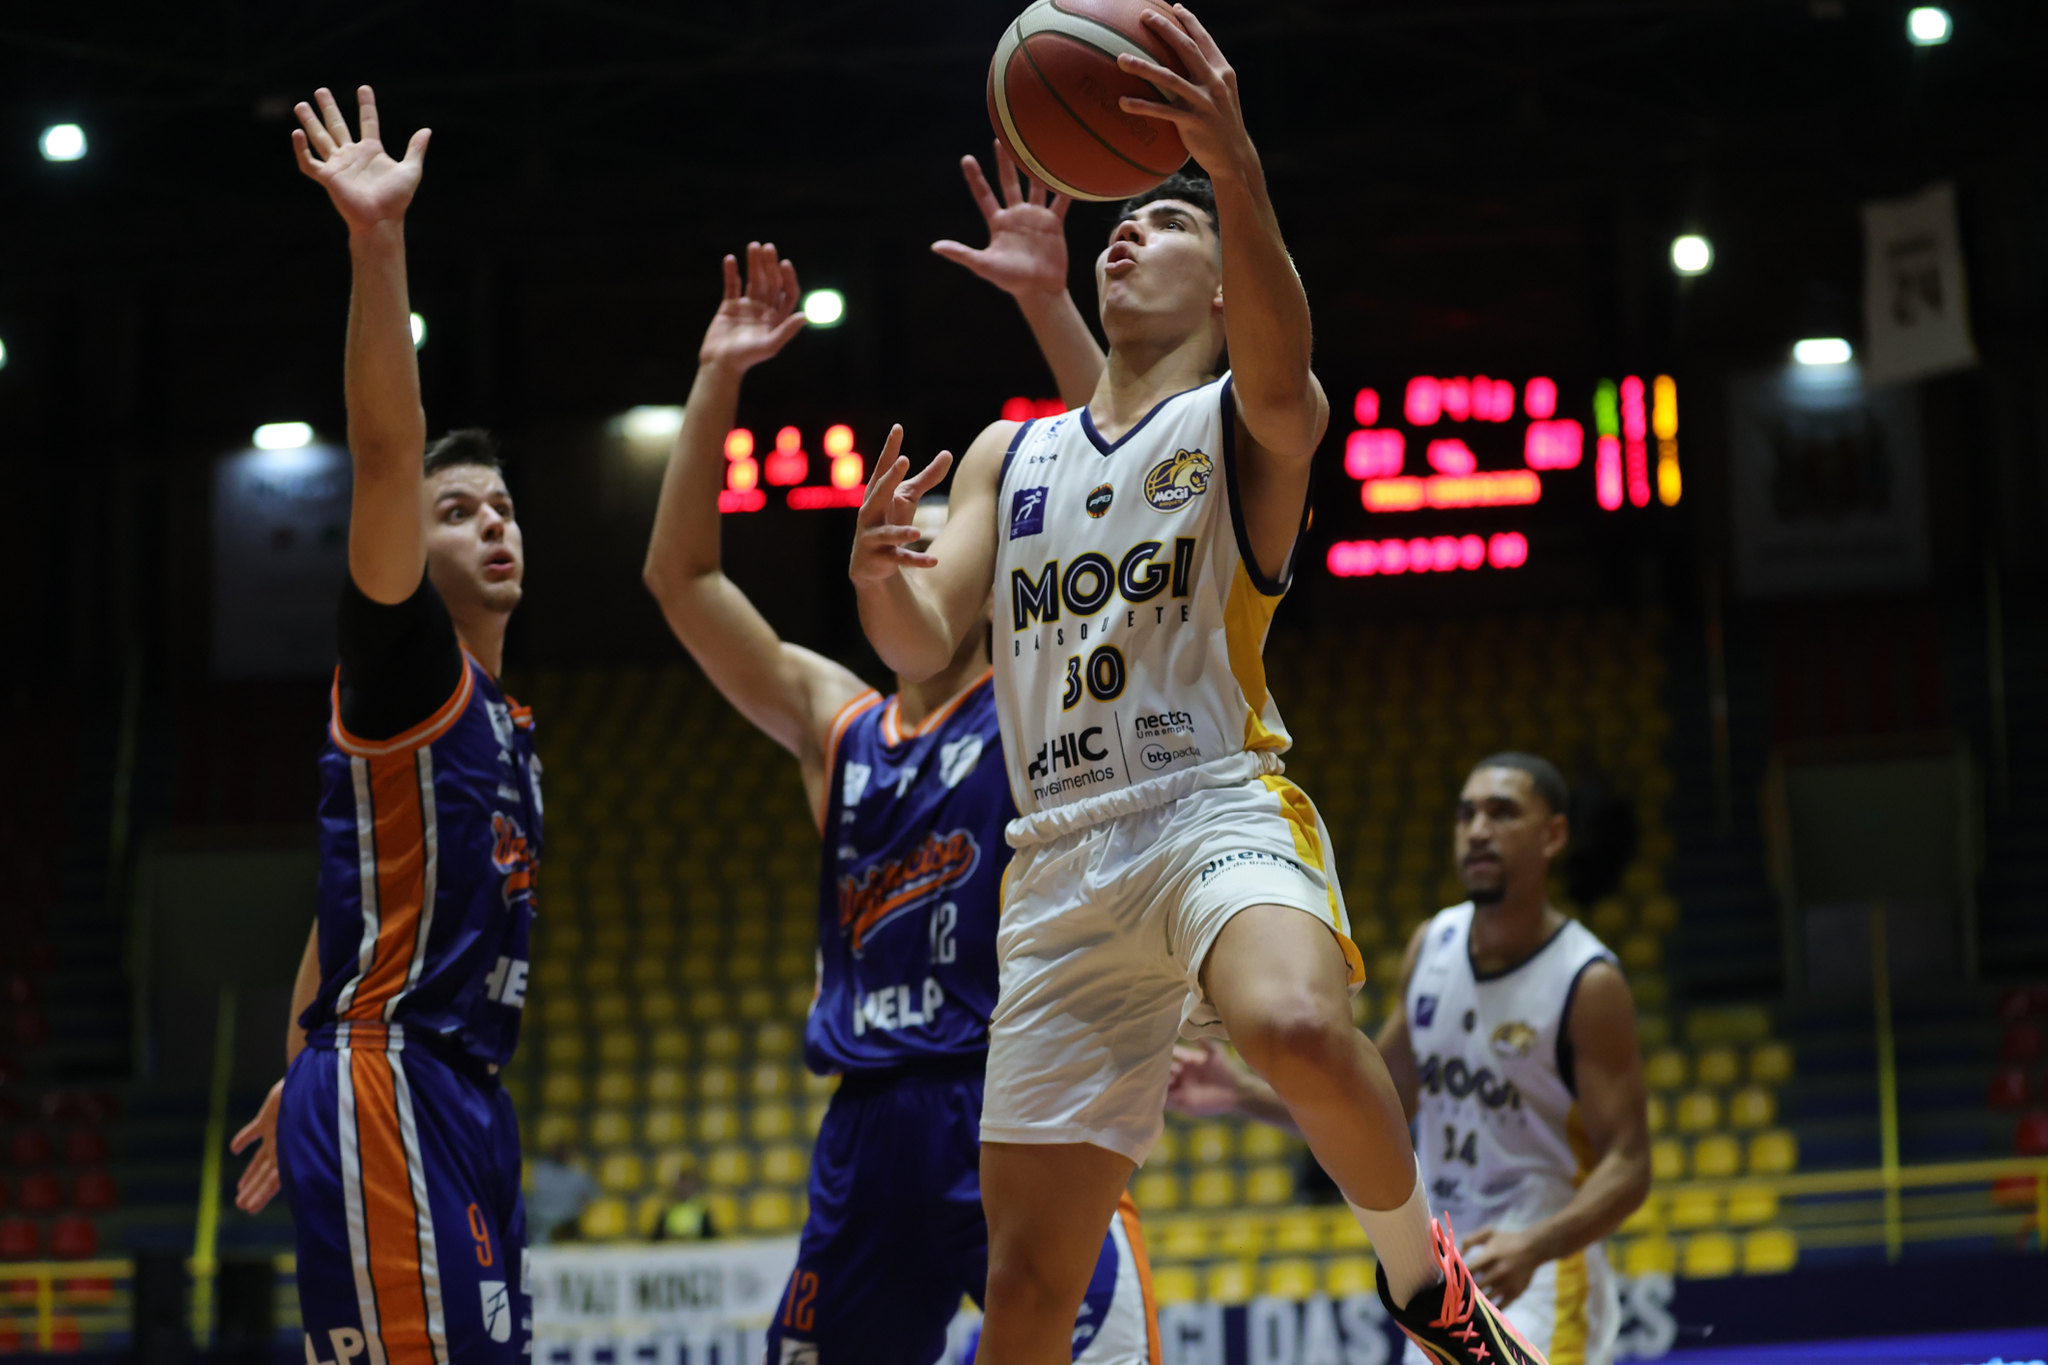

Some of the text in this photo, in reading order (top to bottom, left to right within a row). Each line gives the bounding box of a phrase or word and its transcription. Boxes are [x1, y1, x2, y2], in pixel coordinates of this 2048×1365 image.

[1153, 487, 1189, 503] MOGI
[1011, 536, 1197, 634] MOGI
[1015, 605, 1189, 657] BASQUETE
[1062, 643, 1128, 713] 30
[1147, 751, 1172, 763] btg
[853, 977, 945, 1037] HELP
[467, 1202, 493, 1267] 9
[783, 1268, 819, 1331] 12
